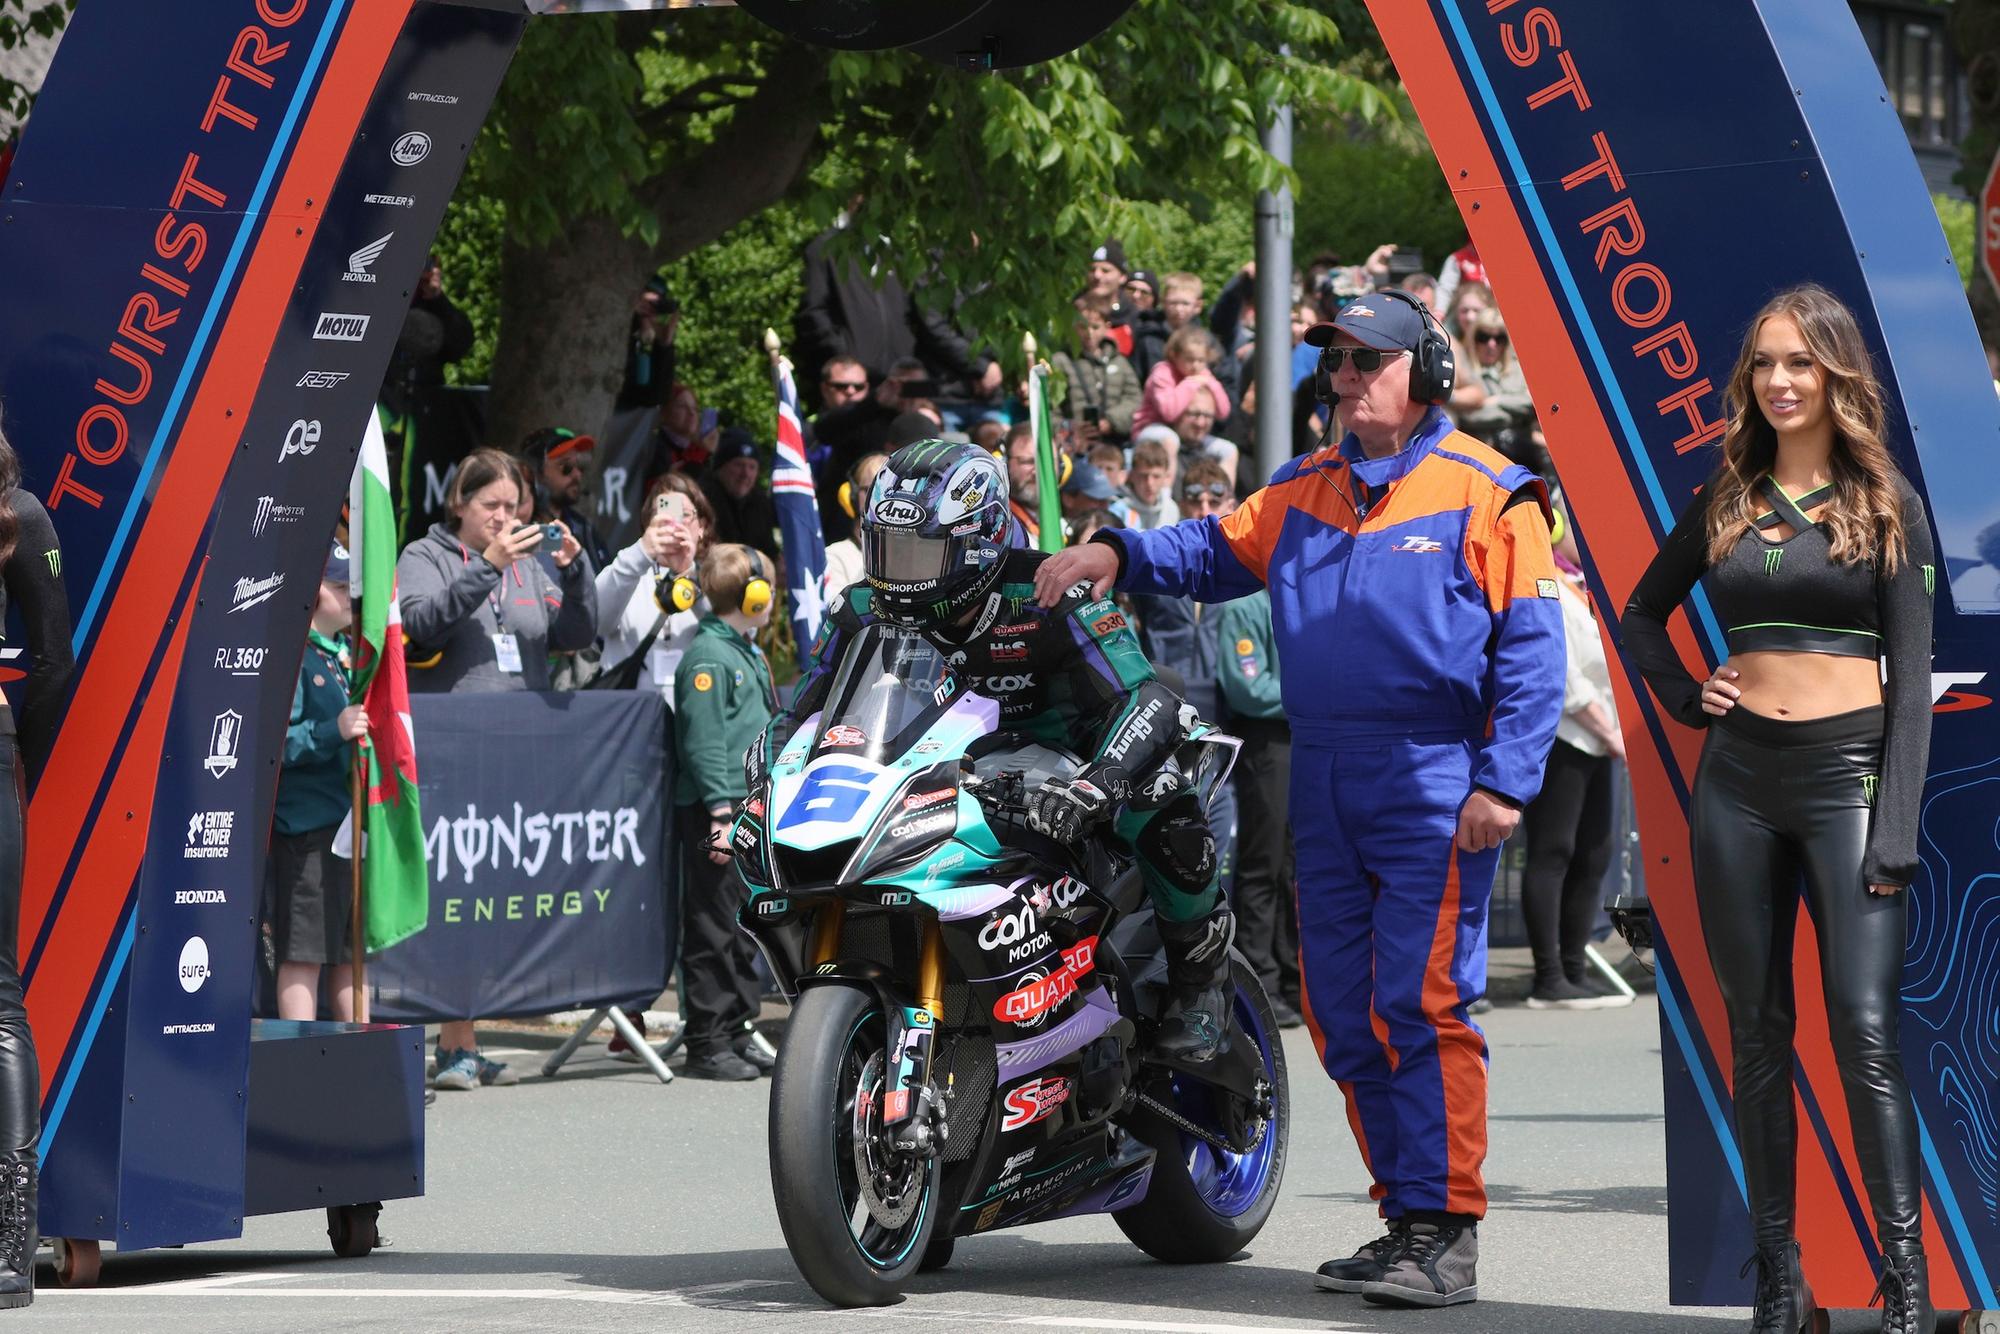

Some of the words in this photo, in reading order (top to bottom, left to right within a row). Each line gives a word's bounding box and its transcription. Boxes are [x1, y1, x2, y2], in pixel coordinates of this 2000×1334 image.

[408, 92, 459, 104] IOMTTRACES.COM
[394, 137, 428, 156] Arai
[364, 194, 407, 206] METZELER
[342, 272, 376, 283] HONDA
[1560, 131, 1729, 492] TROPH
[47, 152, 228, 509] TOURIST
[318, 317, 365, 337] MOTUL
[296, 371, 350, 388] RST
[876, 502, 918, 520] Arai
[233, 572, 286, 604] Milwaukee
[994, 623, 1036, 635] QUATTRO
[776, 765, 879, 831] 6
[204, 811, 235, 829] ENTIRE
[202, 829, 231, 845] COVER
[184, 844, 229, 858] insurance
[175, 890, 226, 904] HONDA
[445, 889, 611, 922] ENERGY
[978, 893, 1036, 951] carl
[915, 1012, 929, 1022] sbs
[163, 1023, 215, 1034] IOMTTRACES.COM
